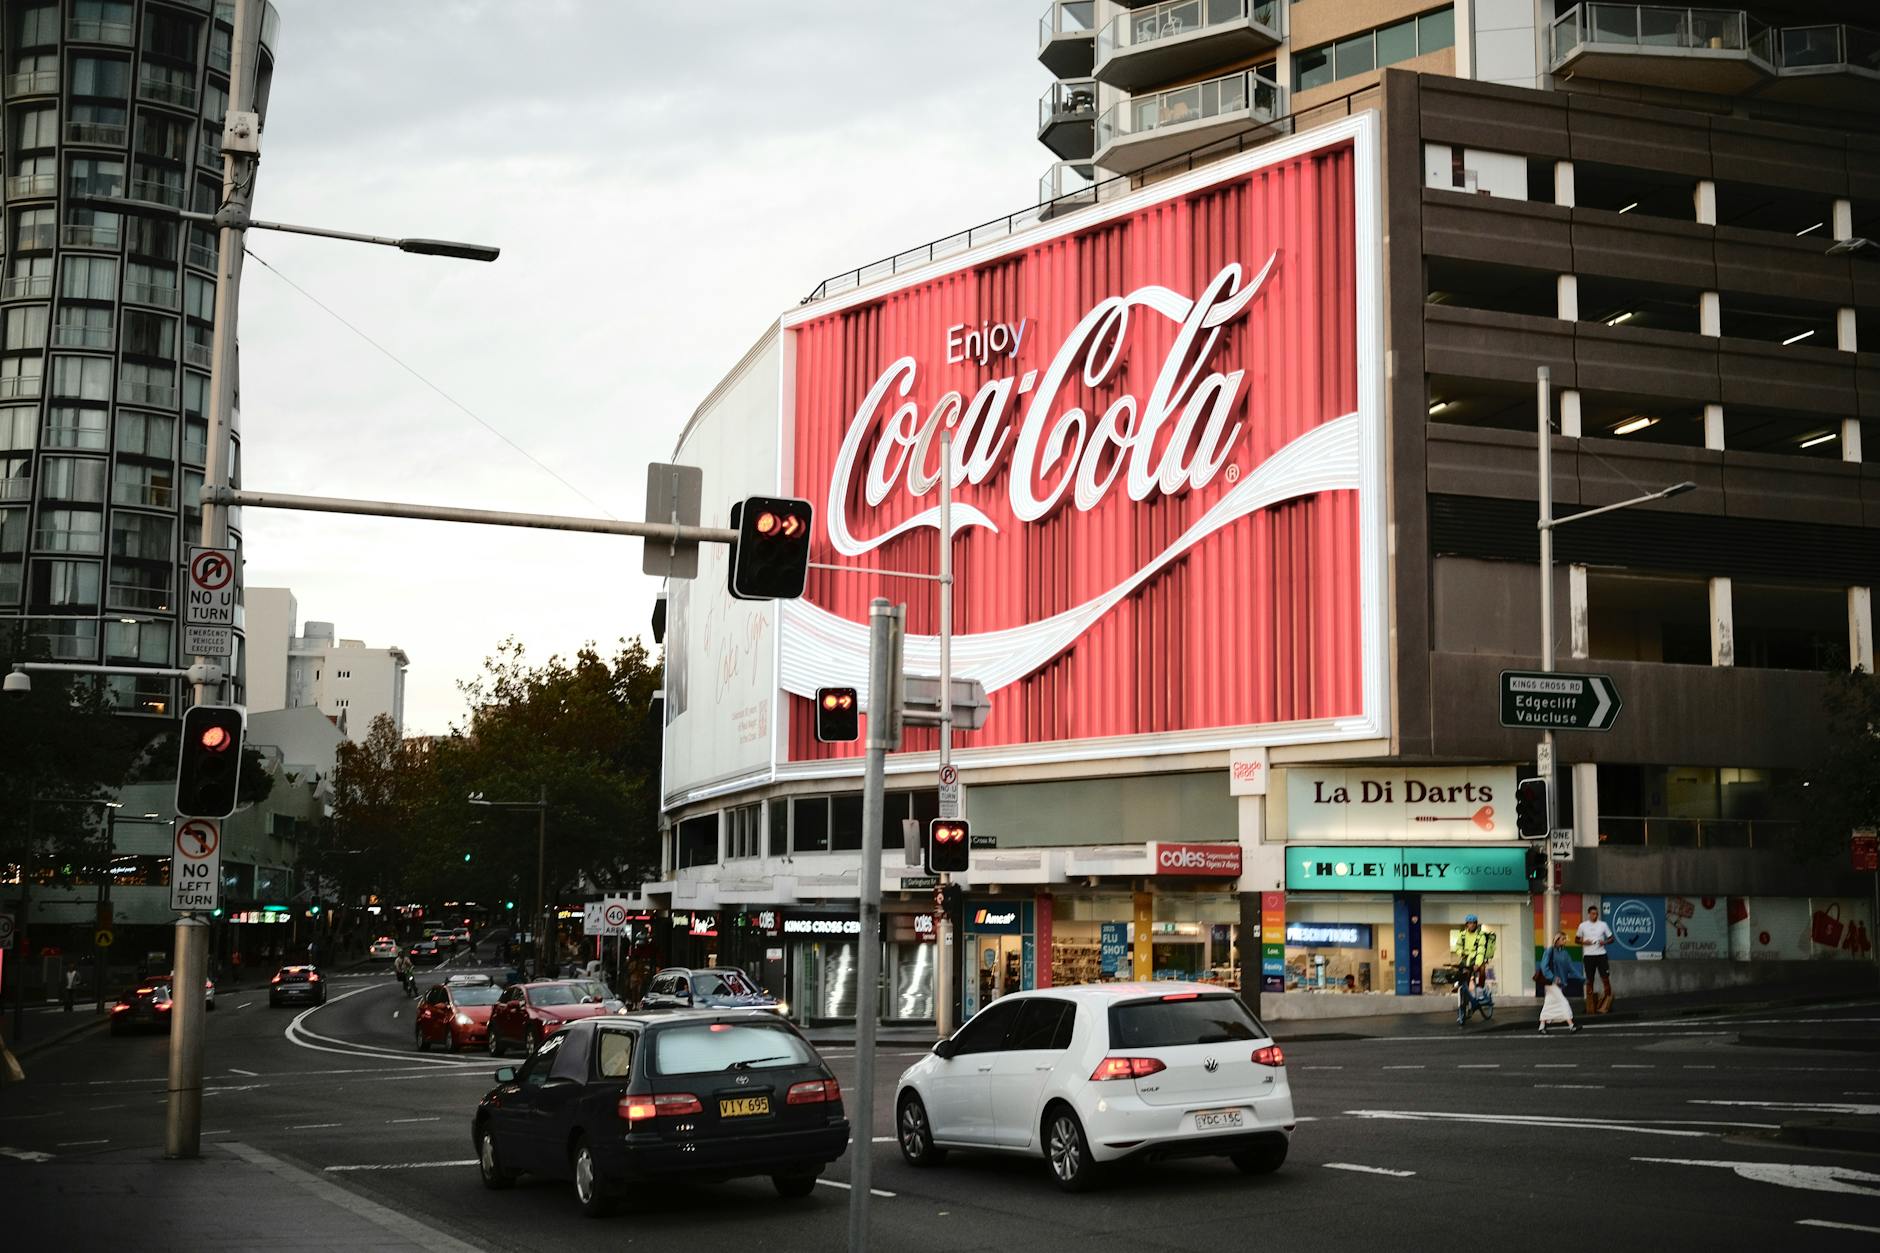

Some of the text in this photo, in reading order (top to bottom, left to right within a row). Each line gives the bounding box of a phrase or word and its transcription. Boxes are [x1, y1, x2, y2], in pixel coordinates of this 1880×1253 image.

[947, 317, 1026, 365] Enjoy
[827, 248, 1281, 556] Coca-Cola
[190, 590, 231, 606] NO U
[192, 607, 228, 620] TURN
[188, 629, 228, 638] EMERGENCY
[192, 636, 225, 645] VEHICLES
[1512, 680, 1580, 691] KINGS CROSS RD
[1515, 695, 1577, 711] Edgecliff
[1516, 710, 1577, 724] Vaucluse
[941, 792, 956, 800] TURN
[1313, 780, 1493, 804] La Di Darts
[1552, 831, 1570, 840] ONE
[1552, 841, 1571, 849] WAY
[1160, 846, 1206, 868] coles
[183, 864, 209, 878] NO
[1316, 861, 1513, 878] HOLEY MOLEY GOLF CLUB
[178, 881, 212, 892] LEFT
[177, 895, 212, 905] TURN
[609, 910, 623, 920] 40
[784, 920, 812, 933] KINGS
[812, 921, 843, 933] CROSS
[1615, 916, 1652, 926] ALWAYS
[1615, 925, 1652, 934] AVAILABLE
[1102, 933, 1119, 943] FLU
[1102, 945, 1125, 955] SHOT
